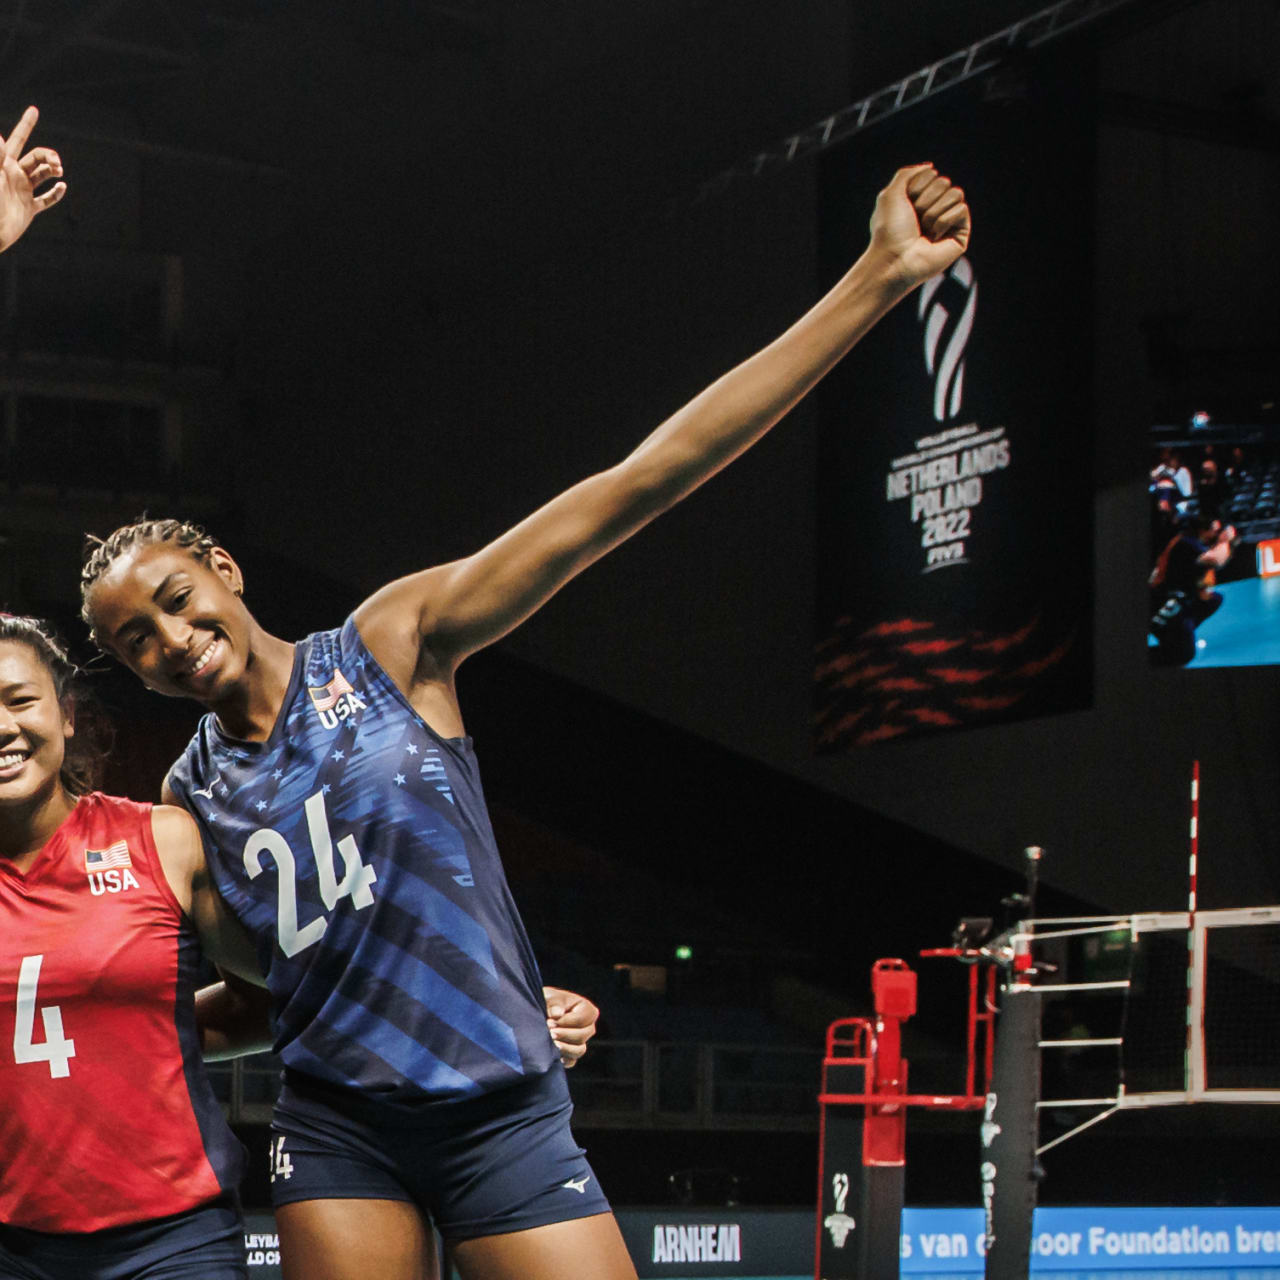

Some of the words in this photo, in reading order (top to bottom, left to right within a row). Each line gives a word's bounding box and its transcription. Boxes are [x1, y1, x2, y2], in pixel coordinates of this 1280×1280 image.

[887, 438, 1010, 501] NETHERLANDS
[910, 476, 983, 522] POLAND
[921, 509, 970, 547] 2022
[318, 691, 367, 731] USA
[87, 869, 140, 897] USA
[243, 792, 378, 959] 24
[14, 954, 76, 1079] 4
[653, 1224, 741, 1263] ARNHEM
[919, 1233, 968, 1258] van
[1032, 1232, 1081, 1257] oor
[1088, 1225, 1229, 1256] Foundation
